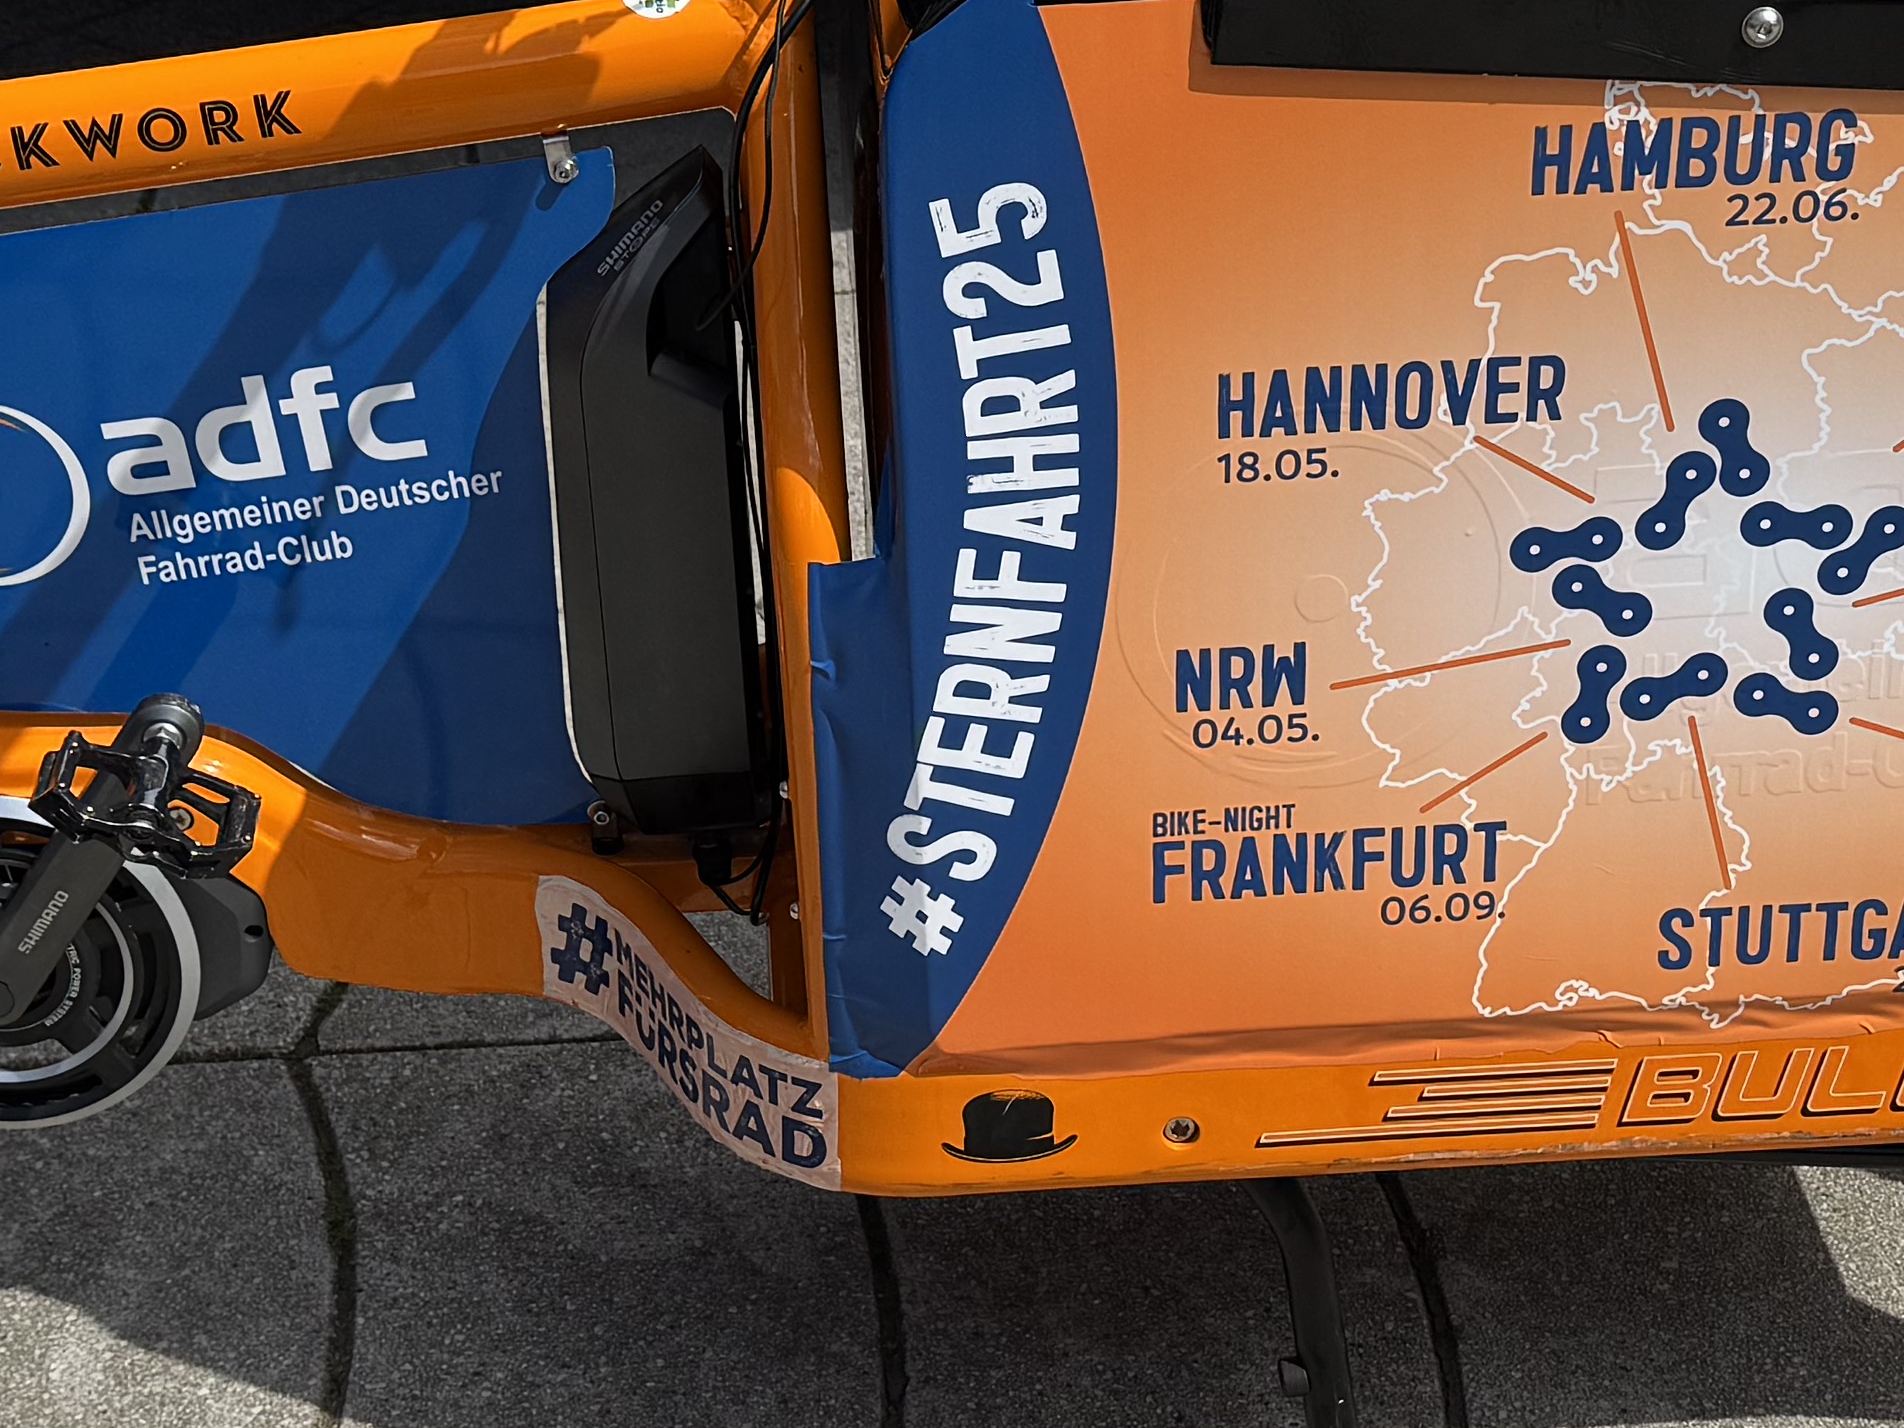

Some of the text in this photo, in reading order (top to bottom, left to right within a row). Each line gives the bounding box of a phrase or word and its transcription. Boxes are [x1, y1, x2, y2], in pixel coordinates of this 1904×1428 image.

[1530, 106, 1860, 197] HAMBURG
[597, 199, 664, 277] SHIMANO
[1724, 188, 1860, 227] 22.06.
[99, 364, 429, 496] adfc
[1216, 354, 1568, 440] HANNOVER
[1216, 447, 1341, 484] 18.05.
[127, 464, 504, 547] Allgemeiner Deutscher
[136, 529, 355, 587] Fahrrad-Club
[879, 180, 1080, 958] #STERNFAHRT25
[1174, 641, 1307, 714] NRW
[1191, 712, 1322, 749] 04.05.
[1151, 803, 1297, 839] BIKE-NIGHT
[1151, 819, 1508, 905] FRANKFURT
[17, 889, 70, 955] SHIMANO
[1379, 891, 1507, 927] 06.09.
[69, 967, 82, 998] POWER
[617, 973, 828, 1170] FÜRSRAD
